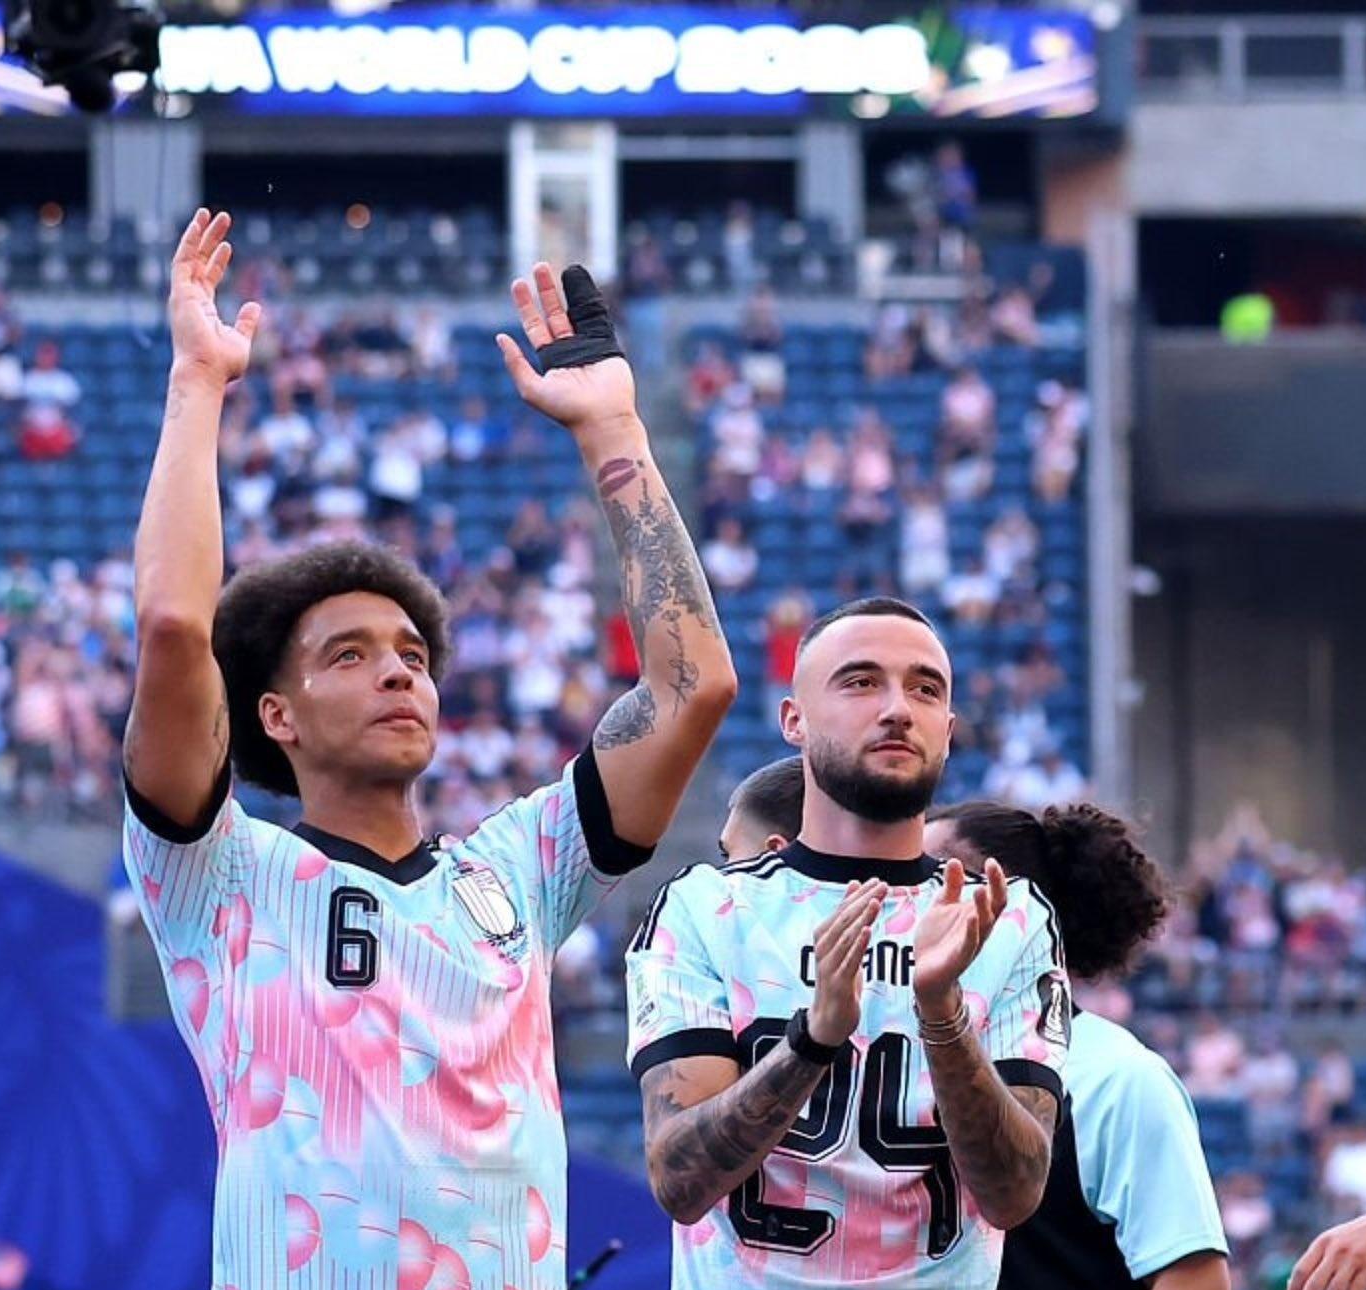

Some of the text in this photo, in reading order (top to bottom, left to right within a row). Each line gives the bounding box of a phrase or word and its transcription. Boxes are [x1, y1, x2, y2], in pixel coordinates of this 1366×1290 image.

[268, 25, 529, 94] WORLD
[529, 24, 677, 94] CUP
[325, 886, 381, 990] 6
